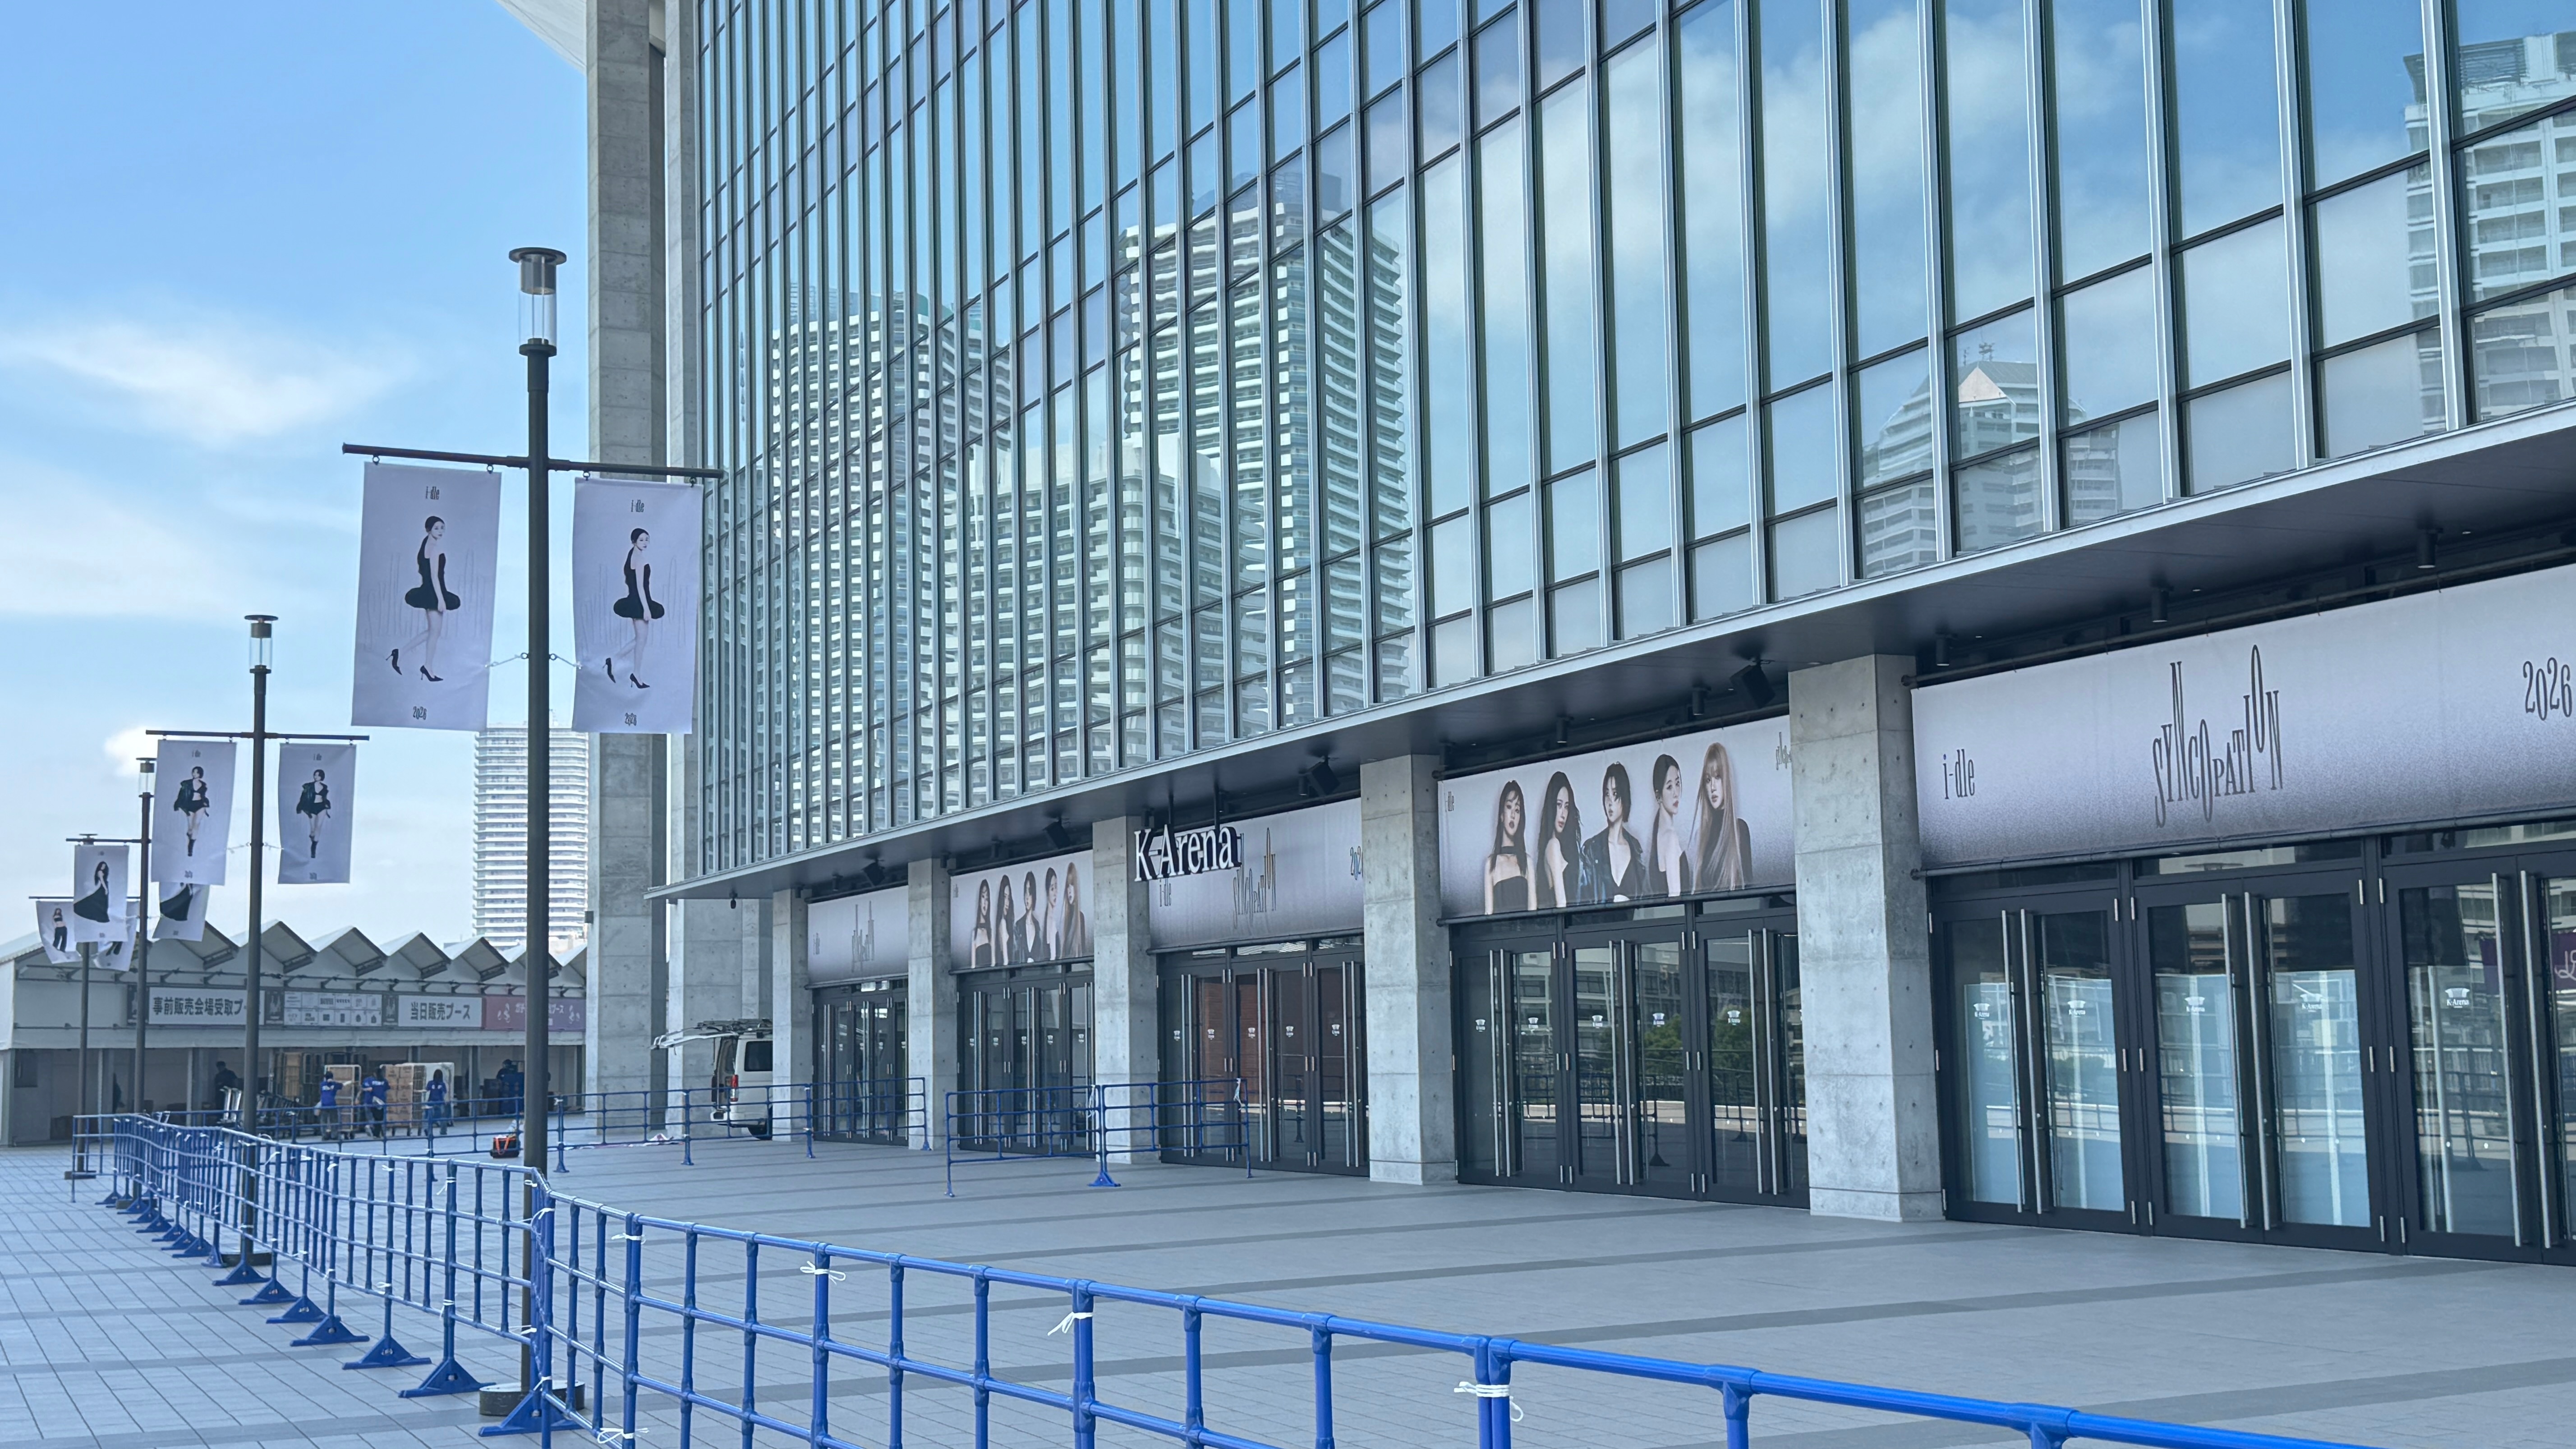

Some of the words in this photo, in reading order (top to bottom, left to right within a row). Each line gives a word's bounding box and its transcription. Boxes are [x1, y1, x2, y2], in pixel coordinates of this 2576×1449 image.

[1942, 749, 1975, 800] i-dle
[2152, 644, 2283, 829] SYNCOPATION
[2523, 657, 2572, 721] 2026
[1134, 824, 1235, 882] K-Arena
[153, 997, 261, 1016] 事前販売会場受取ブ
[411, 997, 470, 1020] 当日販売ブース
